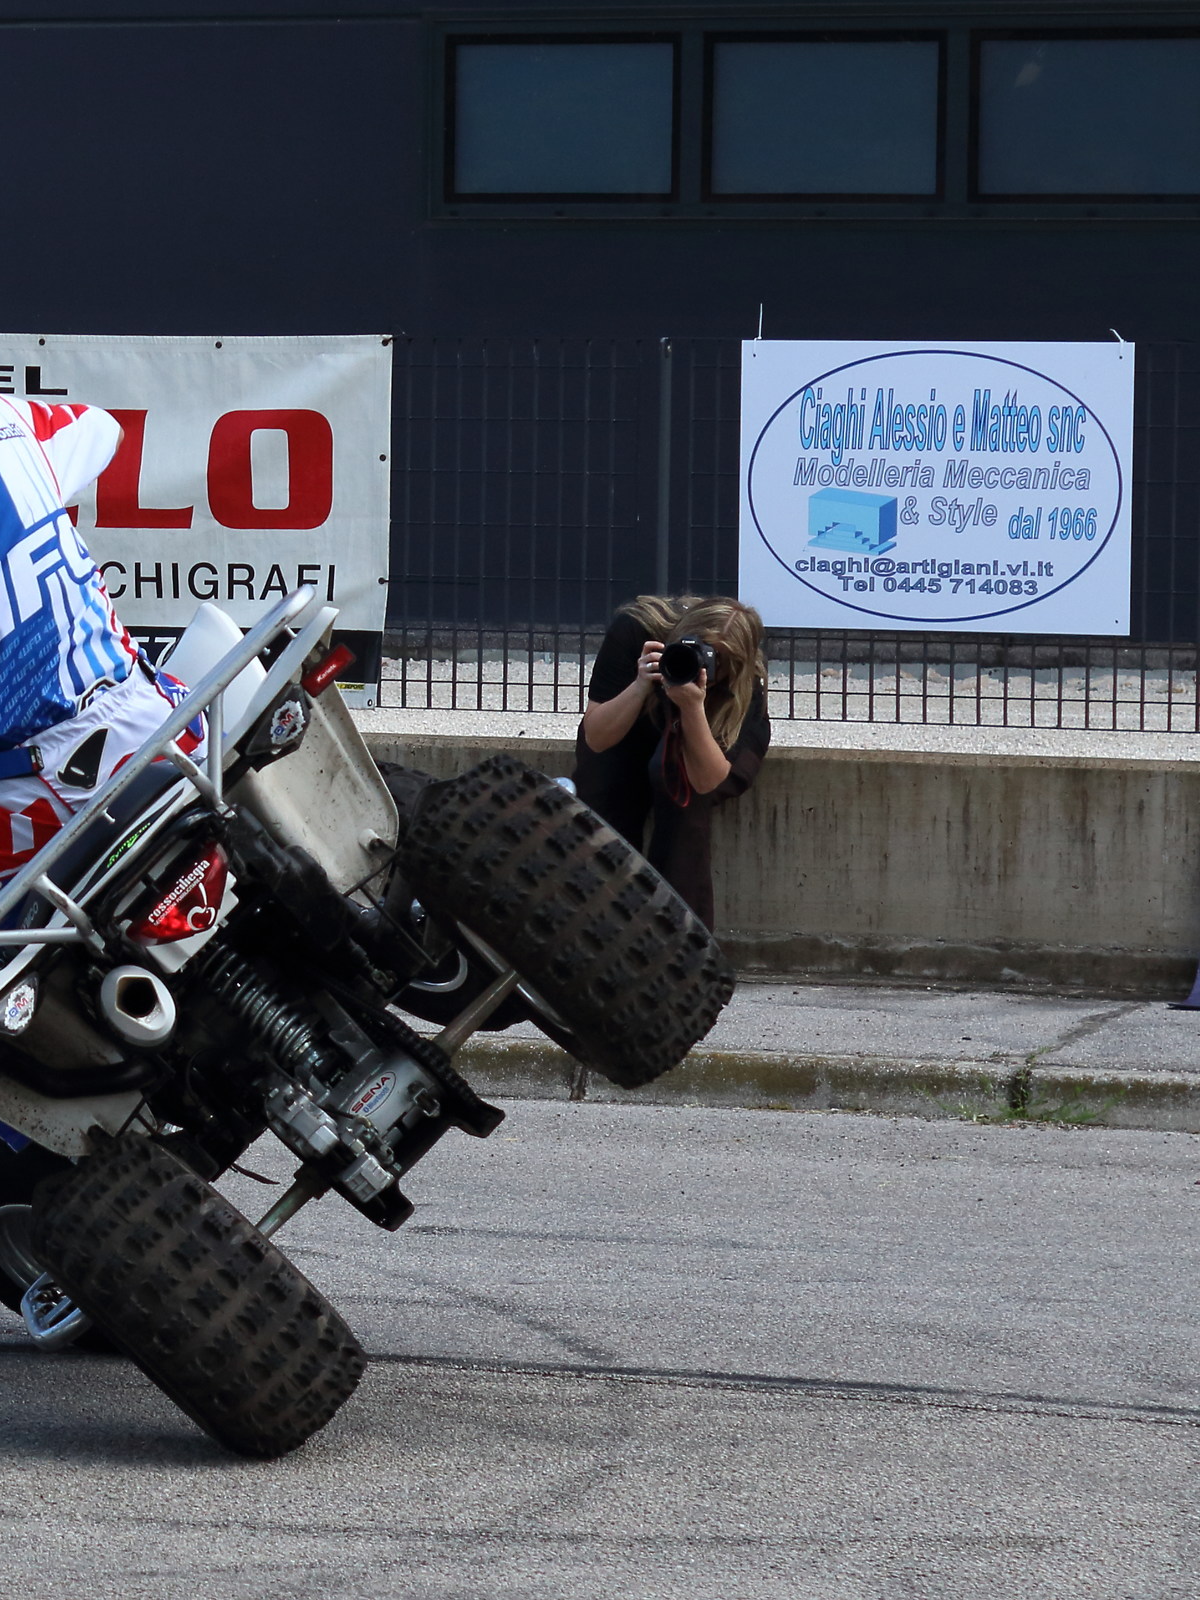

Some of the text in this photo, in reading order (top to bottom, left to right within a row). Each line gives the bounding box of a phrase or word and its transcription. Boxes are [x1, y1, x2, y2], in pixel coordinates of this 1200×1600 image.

[800, 386, 1086, 466] Ciaghi Alessio e Matteo snc
[793, 456, 1091, 490] Modelleria Meccanica
[900, 495, 999, 533] & Style
[1008, 507, 1098, 541] dal 1966
[794, 557, 1054, 578] ciaghi@artigiani.vi.it
[837, 576, 1039, 596] Tel 0445 714083
[148, 860, 211, 923] rossociliegia
[350, 1074, 391, 1114] SENA
